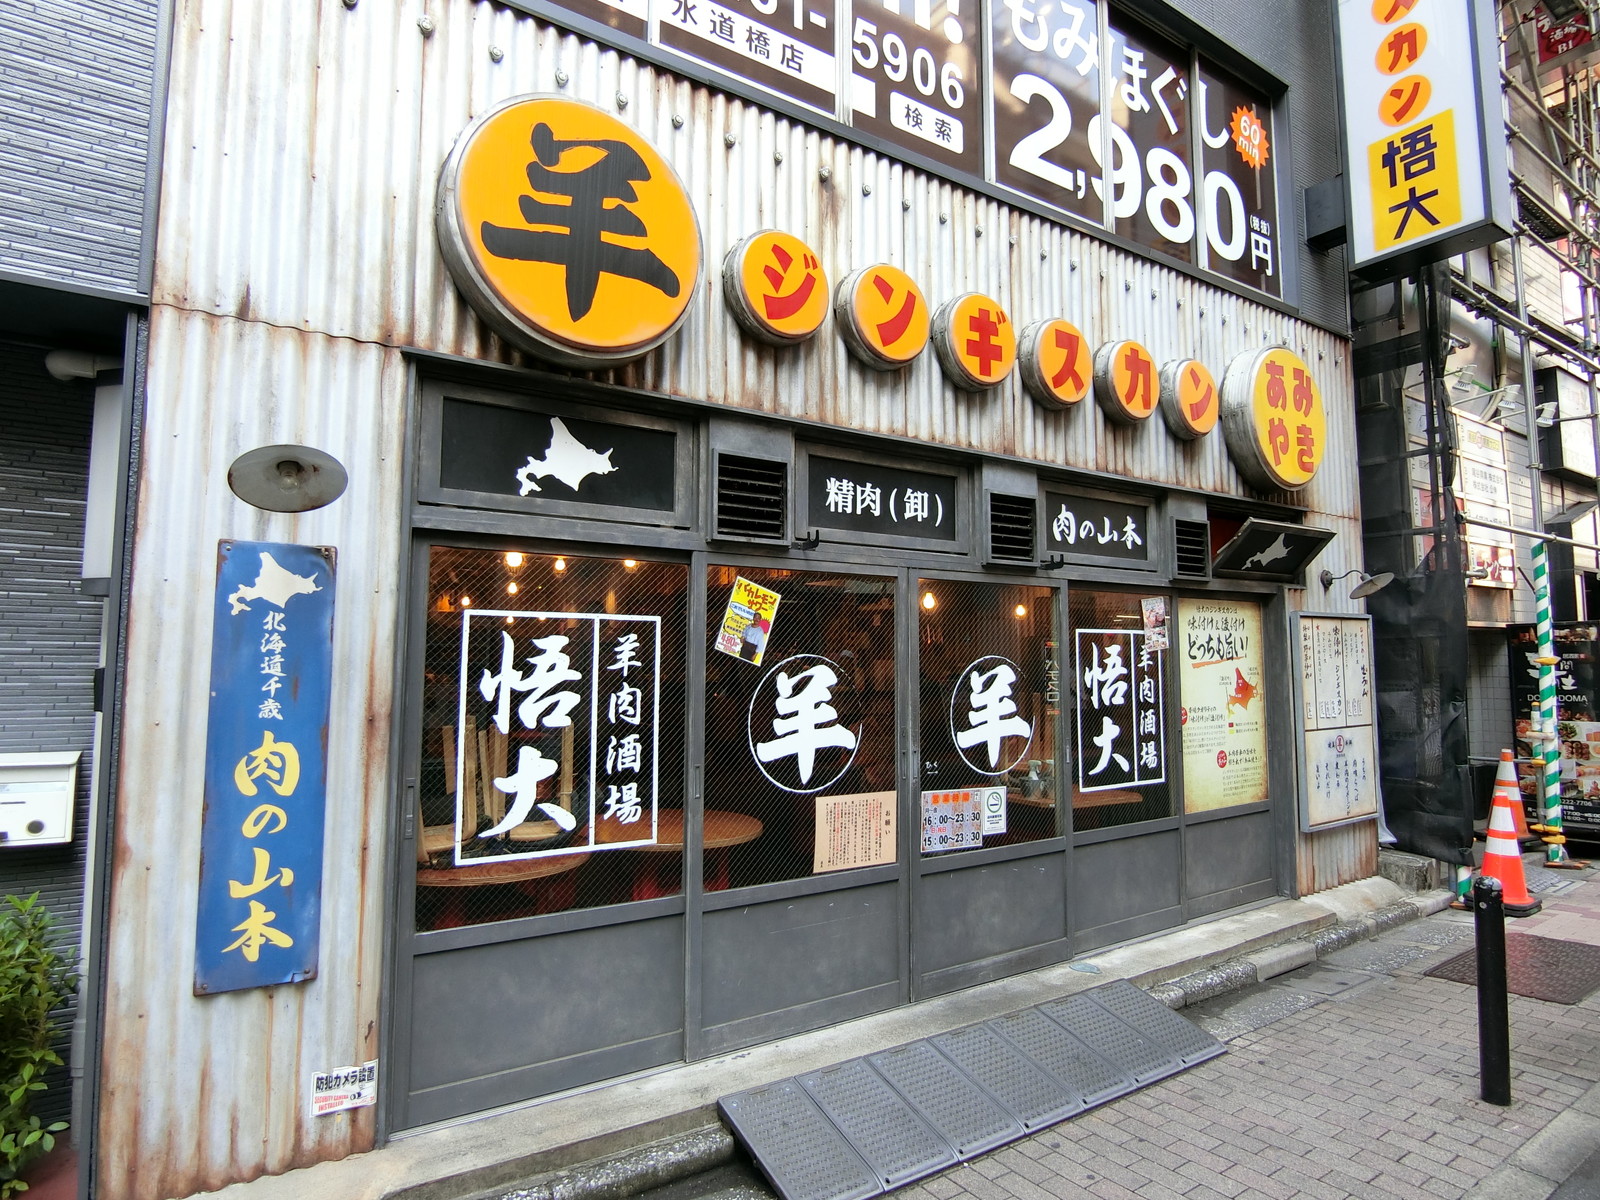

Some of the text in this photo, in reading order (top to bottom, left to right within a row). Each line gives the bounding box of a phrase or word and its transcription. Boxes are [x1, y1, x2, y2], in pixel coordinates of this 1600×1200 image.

[671, 0, 804, 74] 水道橋店
[904, 104, 952, 143] 検索
[1238, 135, 1260, 162] min
[1240, 115, 1260, 146] 60
[481, 122, 680, 323] 羊
[1382, 124, 1441, 241] 悟大
[762, 243, 1213, 423] ジンギスカン
[825, 476, 944, 528] 精肉(卸)
[1052, 503, 1142, 550] 肉の山本
[258, 610, 288, 720] 北海道千歳
[957, 665, 1031, 769] 羊
[1084, 642, 1130, 776] 悟大
[479, 630, 583, 838] 悟大
[604, 633, 643, 826] 羊肉酒場
[757, 664, 856, 785] 羊
[221, 730, 300, 962] 肉の山本
[315, 1066, 375, 1092] 防犯カメラ設置
